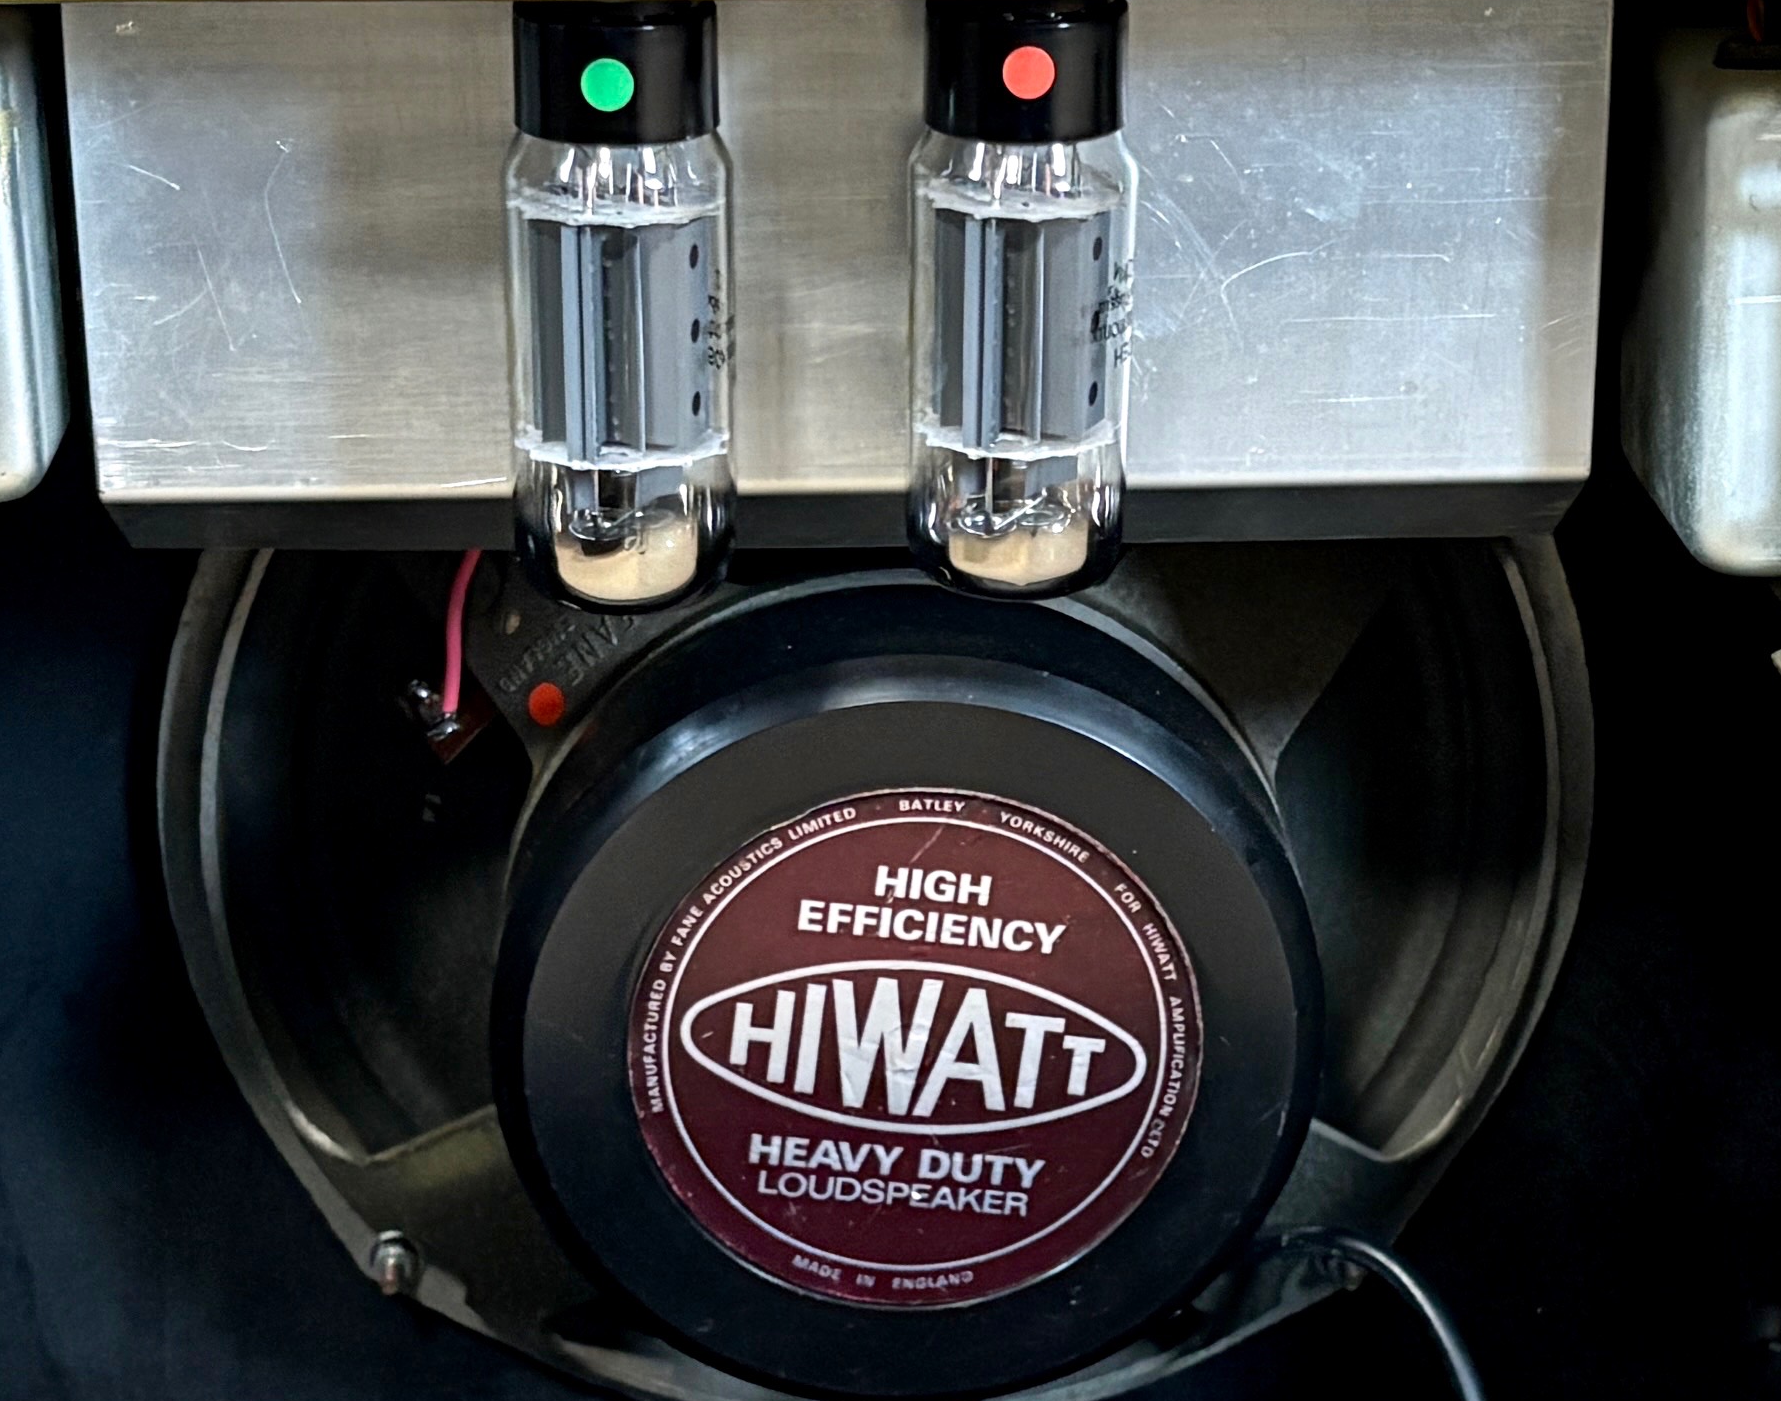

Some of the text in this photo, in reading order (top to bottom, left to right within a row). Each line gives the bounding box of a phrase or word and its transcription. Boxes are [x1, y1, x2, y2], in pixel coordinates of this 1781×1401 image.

[874, 865, 992, 906] HIGH
[797, 899, 1067, 954] EFFICIENCY
[642, 979, 666, 1113] MANUFACTURED
[660, 951, 677, 972] BY
[671, 905, 703, 946] FANE
[702, 837, 784, 905] ACOUSTICS
[788, 807, 857, 840] LIMITED
[899, 798, 966, 812] BATLEY
[1000, 811, 1090, 864] YORKSHIRE
[1114, 883, 1142, 914] FOR
[1143, 923, 1177, 982] HIWATT
[1162, 996, 1186, 1119] AMPLIFICATION
[729, 977, 1106, 1118] HIWATT
[748, 1133, 1046, 1189] HEAVY DUTY
[757, 1170, 1029, 1217] LOUDSPEAKER
[792, 1254, 974, 1290] MADE IN ENGLAND
